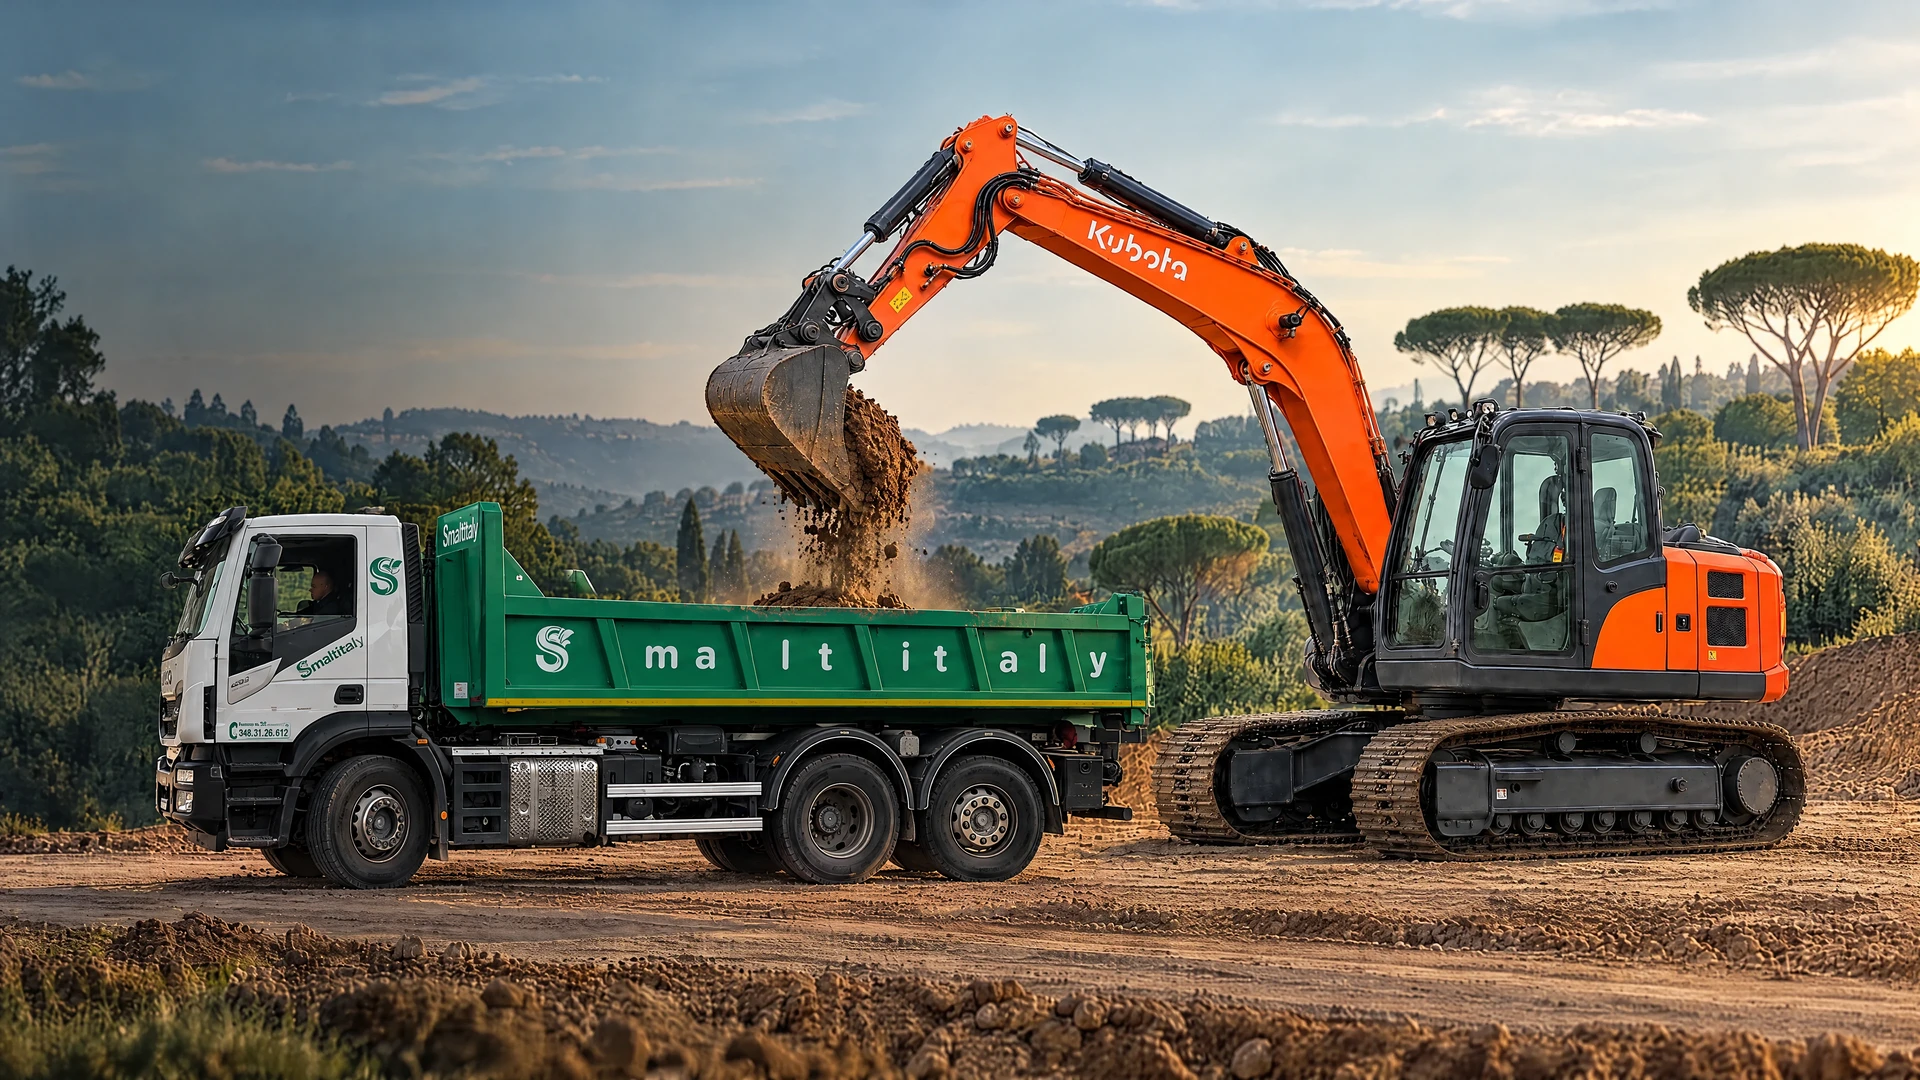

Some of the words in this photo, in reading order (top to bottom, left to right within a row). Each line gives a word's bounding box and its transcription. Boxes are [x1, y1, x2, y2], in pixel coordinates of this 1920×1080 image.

[1087, 219, 1189, 282] Kubota
[442, 516, 479, 548] Smaltitaly
[296, 635, 364, 678] Smaltitaly
[238, 728, 289, 737] 348.31.26.612
